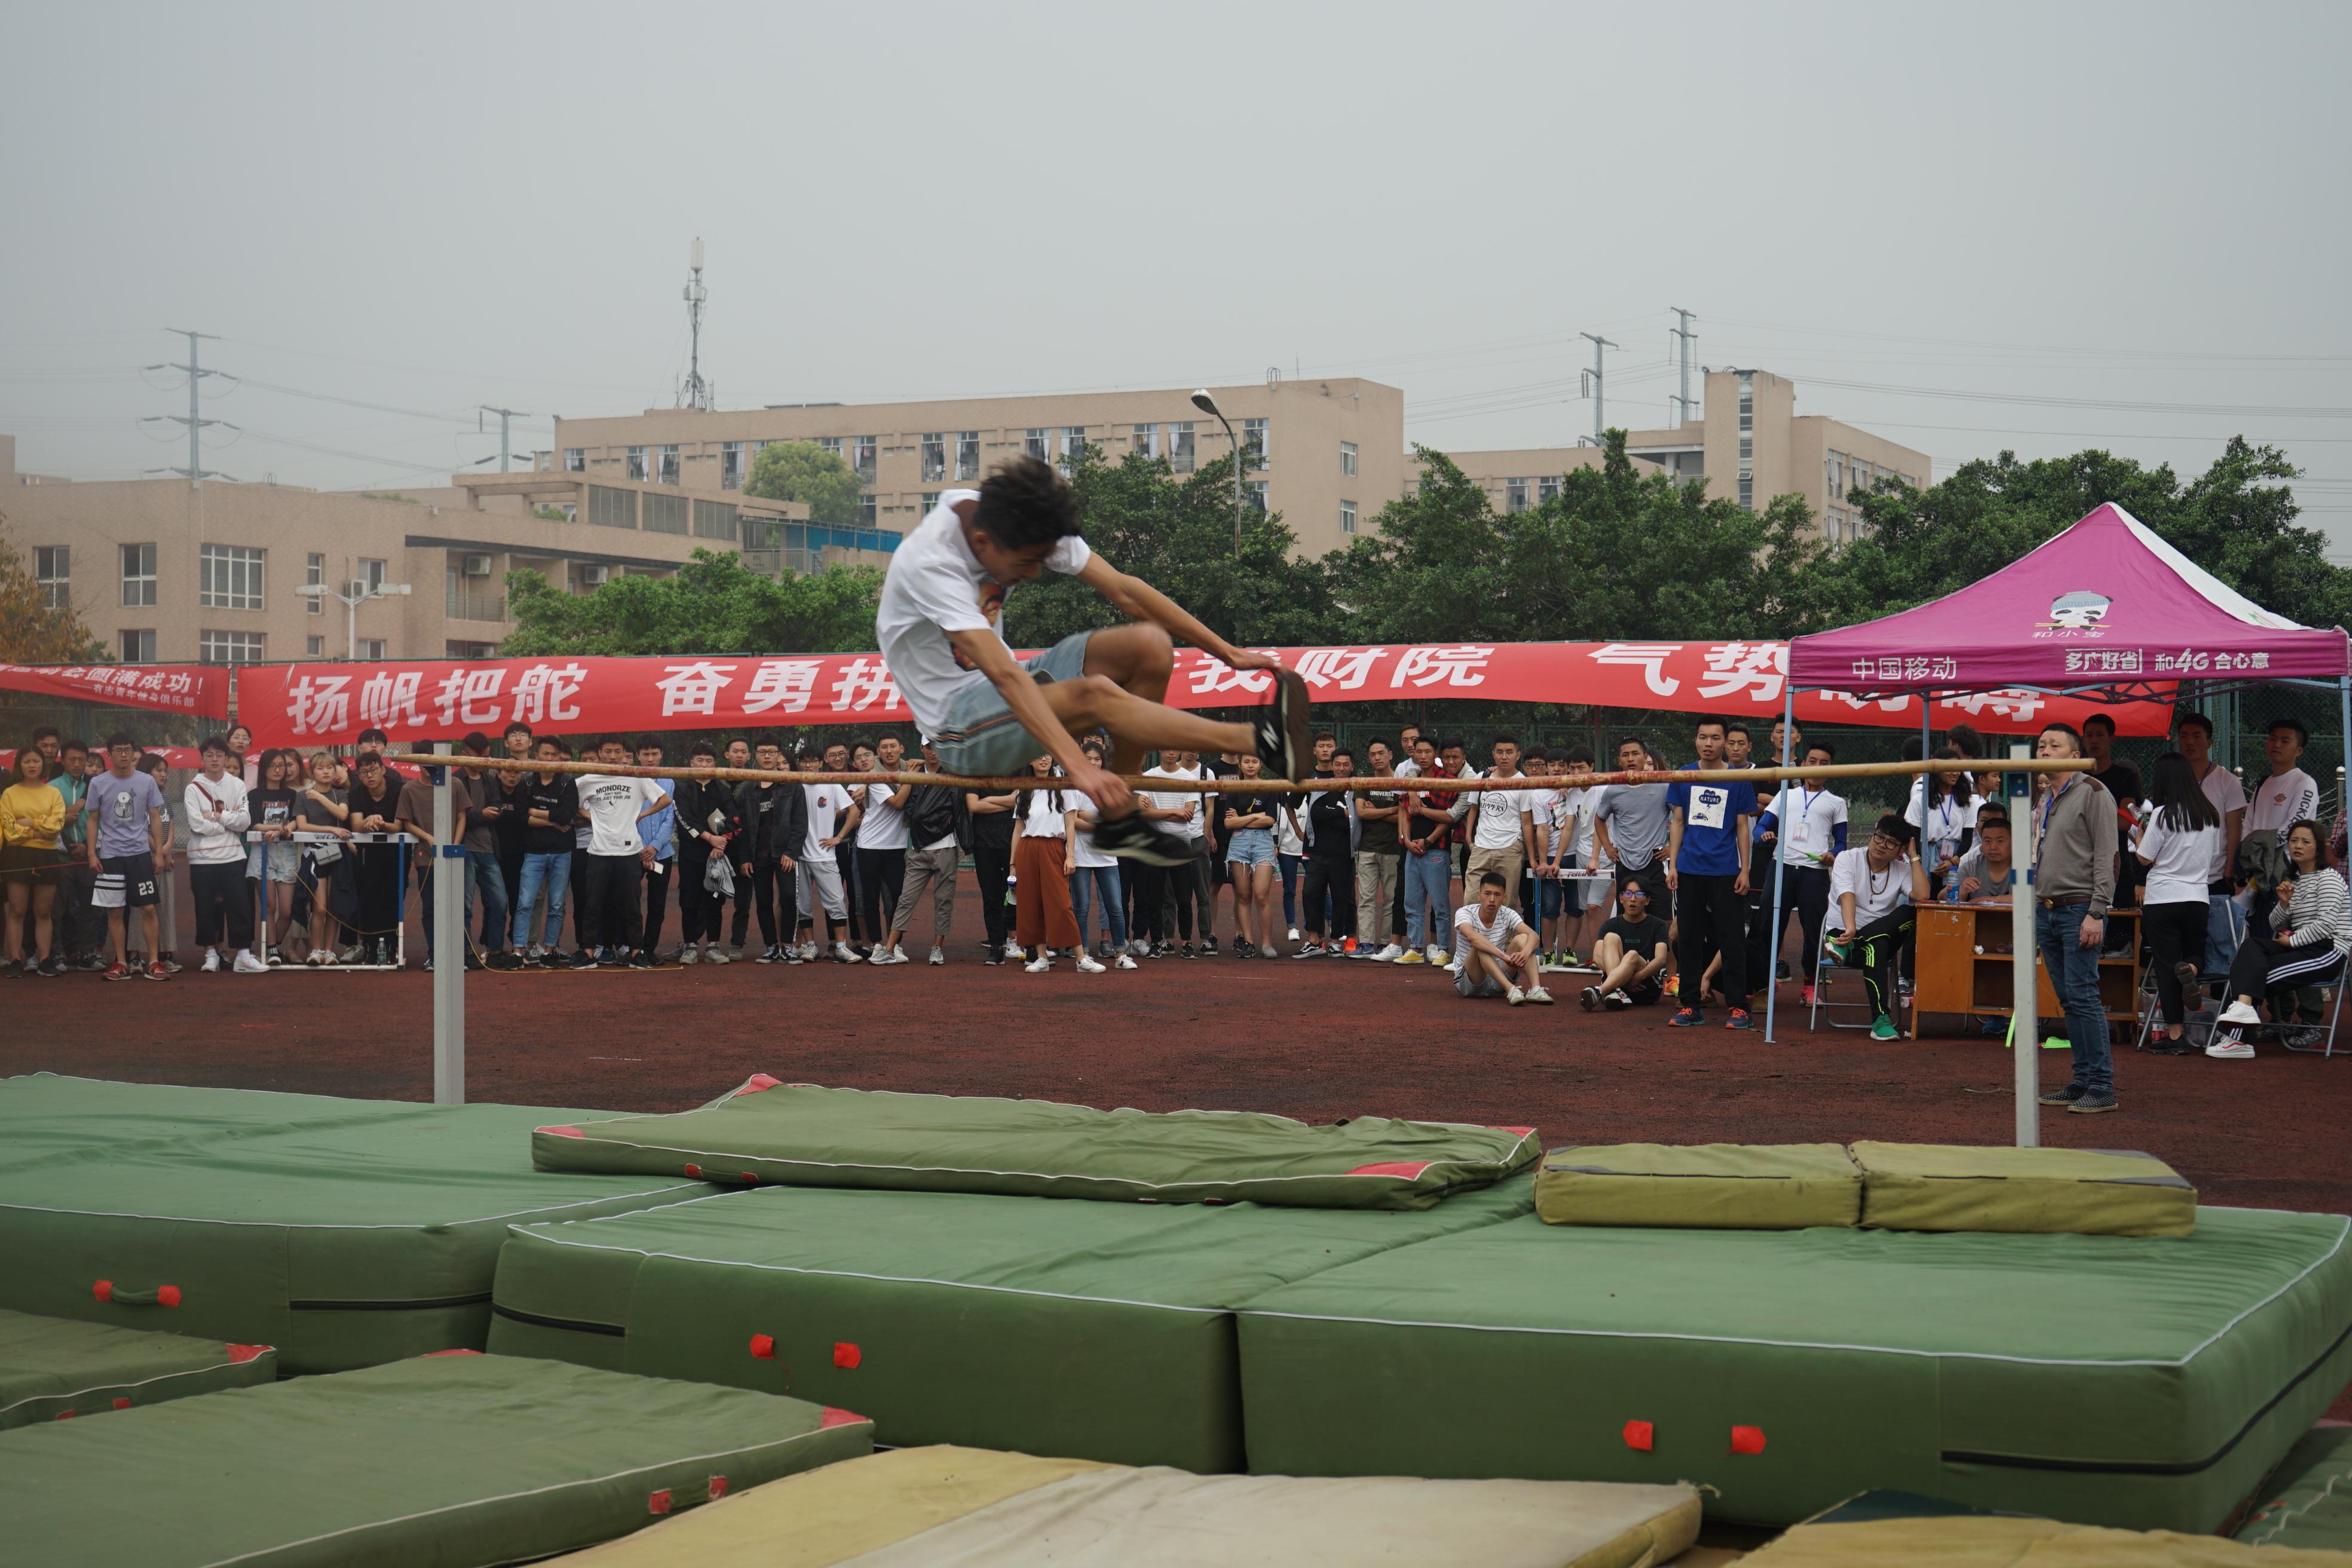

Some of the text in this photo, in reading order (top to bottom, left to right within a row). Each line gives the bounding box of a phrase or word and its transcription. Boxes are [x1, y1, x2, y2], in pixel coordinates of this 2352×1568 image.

[1852, 656, 1957, 681] 中国移动
[287, 662, 588, 734] 扬帆把舵
[1174, 646, 1495, 694] 我财院
[596, 785, 632, 795] MONDAZE
[1700, 795, 1720, 804] NATURE
[138, 880, 155, 896] 23
